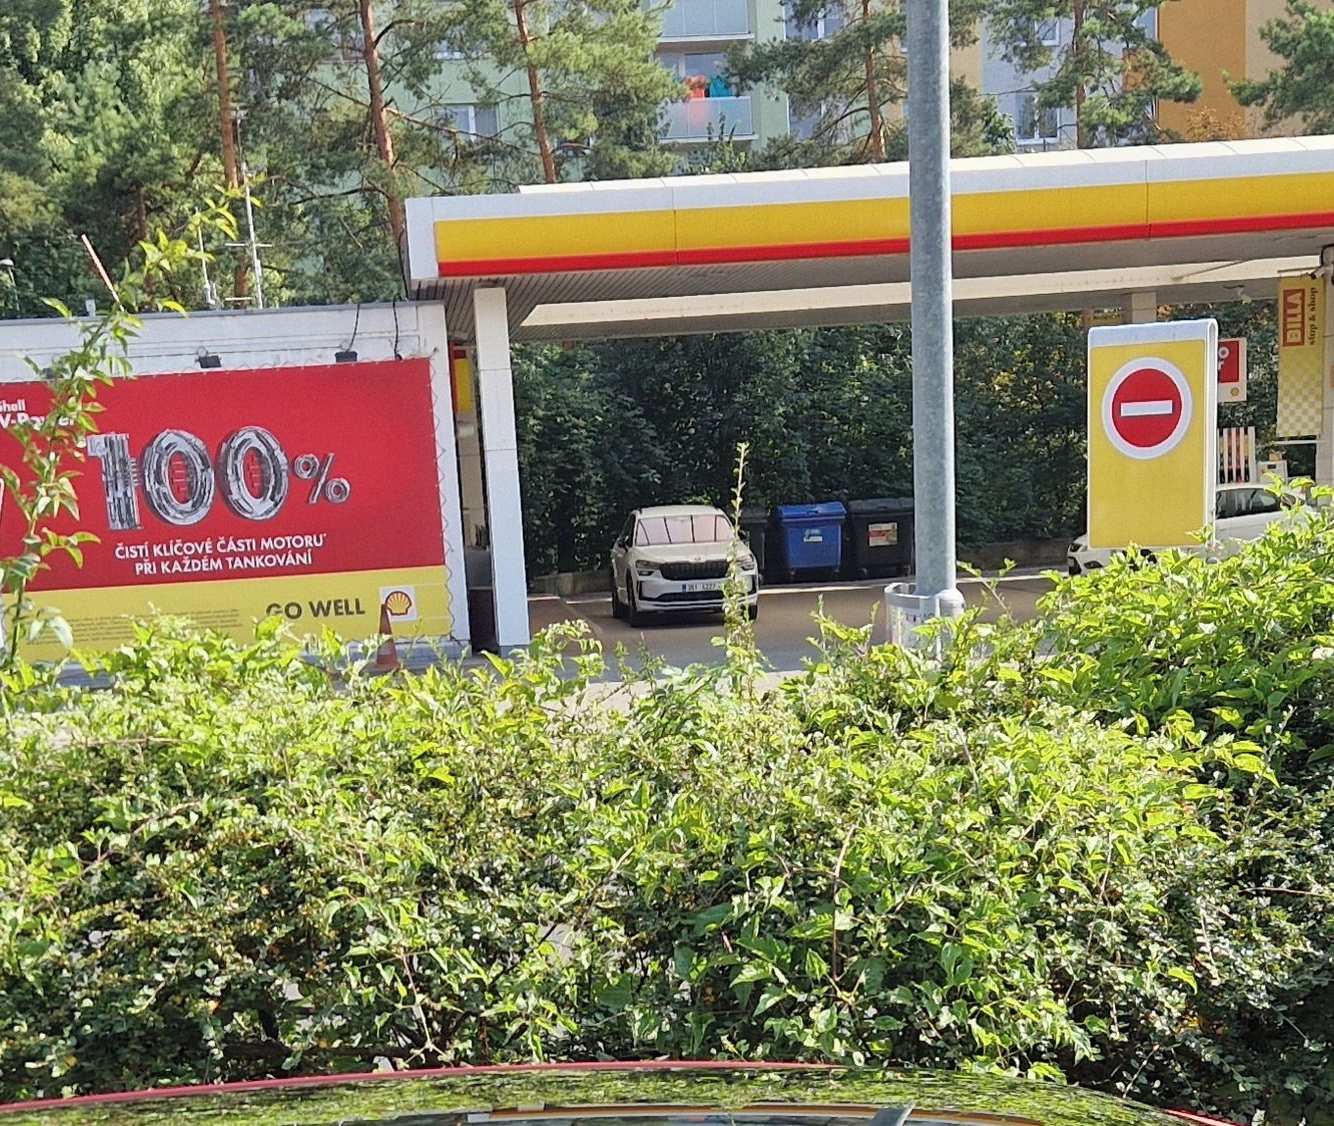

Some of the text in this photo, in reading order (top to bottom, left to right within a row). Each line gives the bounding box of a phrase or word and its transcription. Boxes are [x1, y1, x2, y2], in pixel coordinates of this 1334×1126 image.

[1308, 287, 1319, 312] shop
[1286, 291, 1303, 343] BILLA
[1308, 323, 1318, 345] stop
[86, 425, 351, 531] 100%
[115, 542, 149, 560] ČISTÍ
[153, 537, 213, 558] KLÍČOVÉ
[217, 536, 256, 553] ČÁSTI
[135, 548, 313, 576] PŘI KAŽDÉM TANKOVÁNÍ
[266, 598, 366, 620] GO WELL
